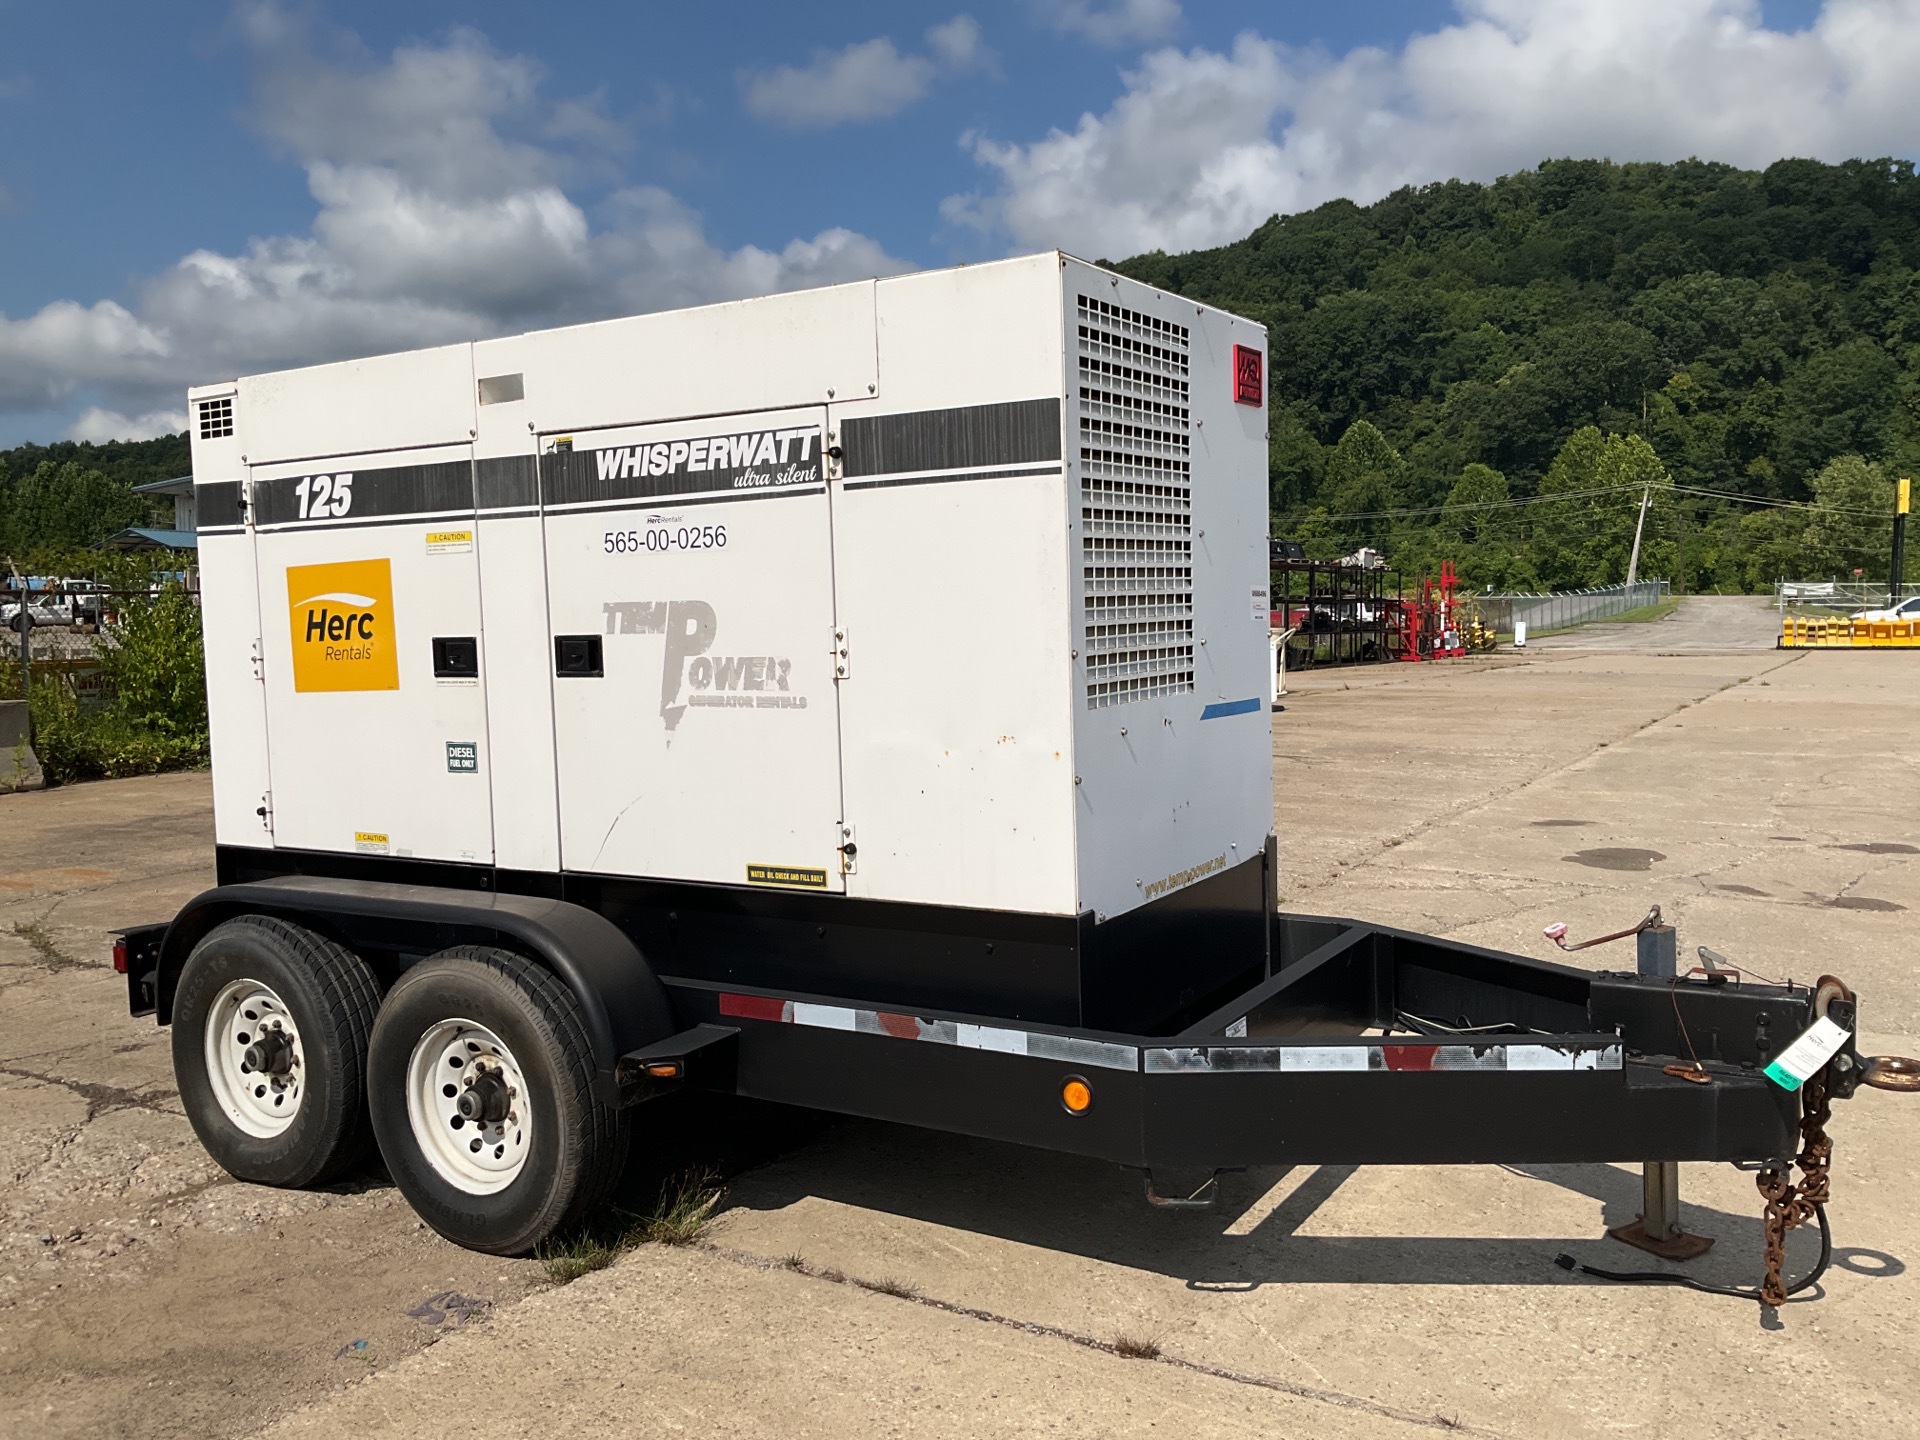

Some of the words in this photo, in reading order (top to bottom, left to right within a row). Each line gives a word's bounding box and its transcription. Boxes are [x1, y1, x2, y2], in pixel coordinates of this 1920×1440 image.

[595, 427, 822, 481] WHISPERWATT
[733, 467, 771, 488] ultra
[775, 462, 817, 485] silent
[295, 473, 353, 519] 125
[438, 533, 466, 541] CAUTION
[604, 525, 727, 553] 565-00-0256
[305, 608, 375, 643] Herc
[325, 644, 372, 661] Rentals
[449, 747, 475, 758] DIESEL
[449, 759, 461, 768] FUEL
[461, 759, 475, 768] ONLY
[362, 833, 387, 842] CAUTION
[750, 869, 765, 879] WATER
[775, 872, 789, 880] CHECK
[790, 873, 799, 881] AND
[800, 874, 810, 882] FILL
[811, 875, 824, 883] DAILY
